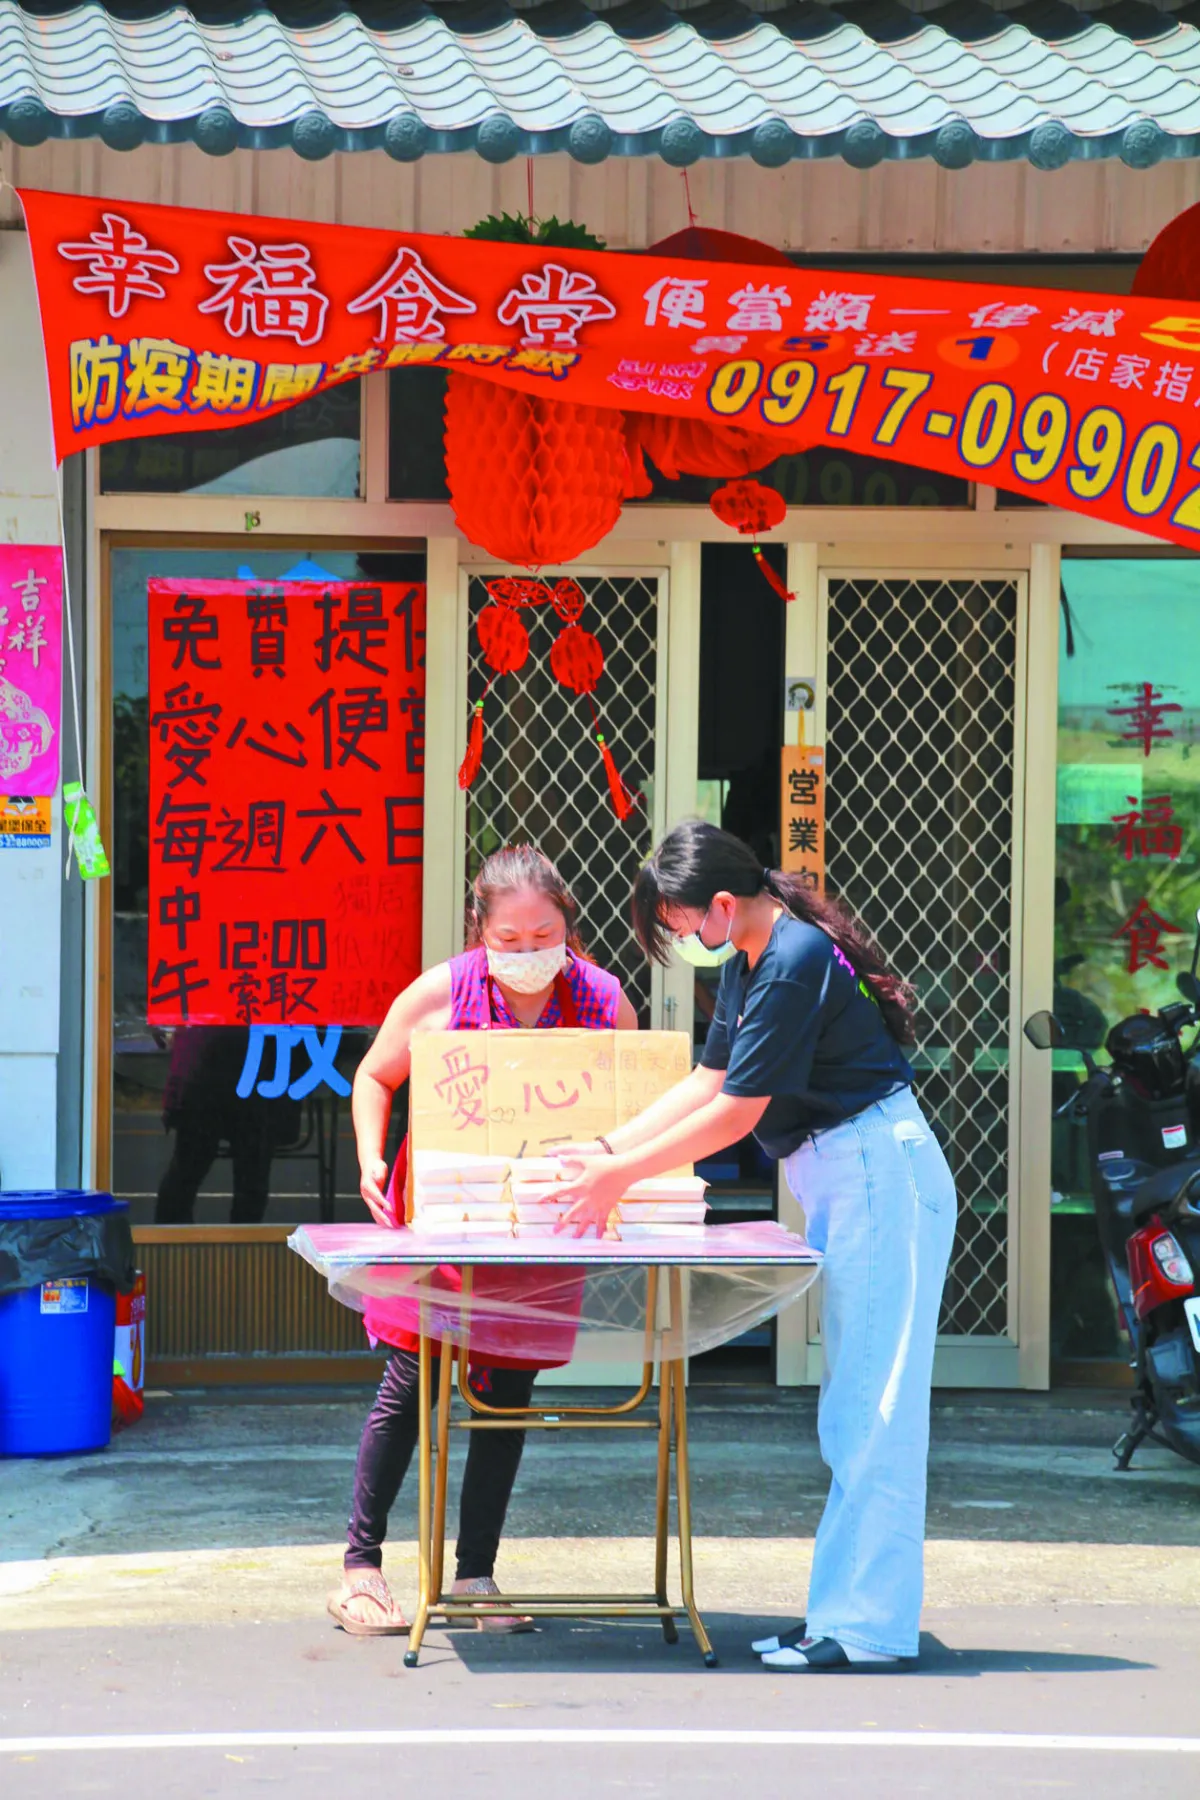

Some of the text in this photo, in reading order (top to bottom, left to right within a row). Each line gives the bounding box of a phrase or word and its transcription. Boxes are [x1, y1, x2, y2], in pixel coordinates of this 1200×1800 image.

[58, 213, 616, 348] 幸福食堂
[1042, 341, 1200, 407] (店家指
[8, 569, 48, 668] 吉祥
[154, 789, 424, 878] 每週六日
[1106, 682, 1184, 975] 幸福食
[151, 886, 209, 1021] 中午
[219, 919, 326, 970] 12:00
[228, 973, 319, 1023] 索取
[434, 1045, 592, 1130] 愛心
